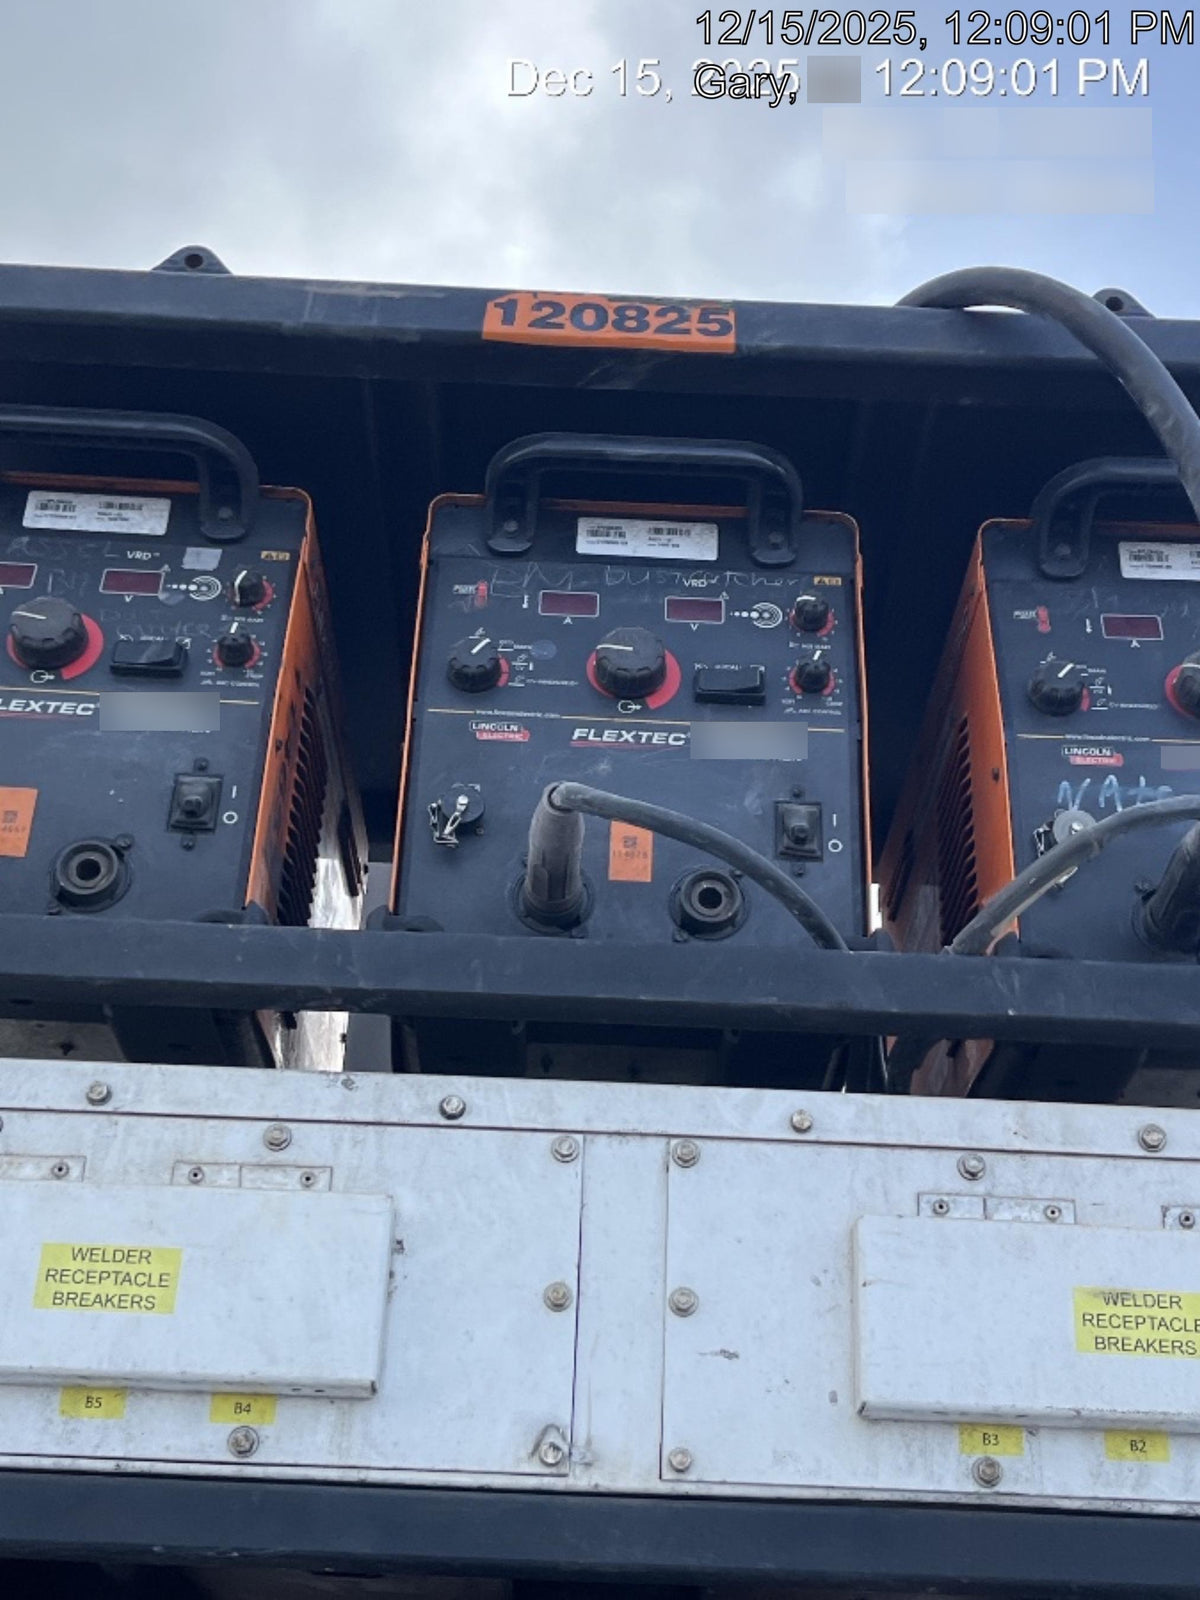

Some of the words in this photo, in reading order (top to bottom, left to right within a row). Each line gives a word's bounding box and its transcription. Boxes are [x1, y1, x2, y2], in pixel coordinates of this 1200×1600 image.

[494, 298, 734, 337] 120825
[472, 722, 519, 733] LINCOLN
[572, 728, 687, 746] FLEXTEC
[1064, 747, 1112, 757] LINCOLN
[71, 1247, 152, 1265] WELDER
[45, 1268, 170, 1288] RECEPTACLE
[52, 1291, 156, 1311] BREAKERS
[1102, 1292, 1183, 1310] WELDER
[1094, 1336, 1198, 1355] BREAKERS
[84, 1396, 102, 1409] B5
[233, 1401, 252, 1414] B4
[982, 1432, 1000, 1446] B3
[1129, 1439, 1147, 1453] B2
